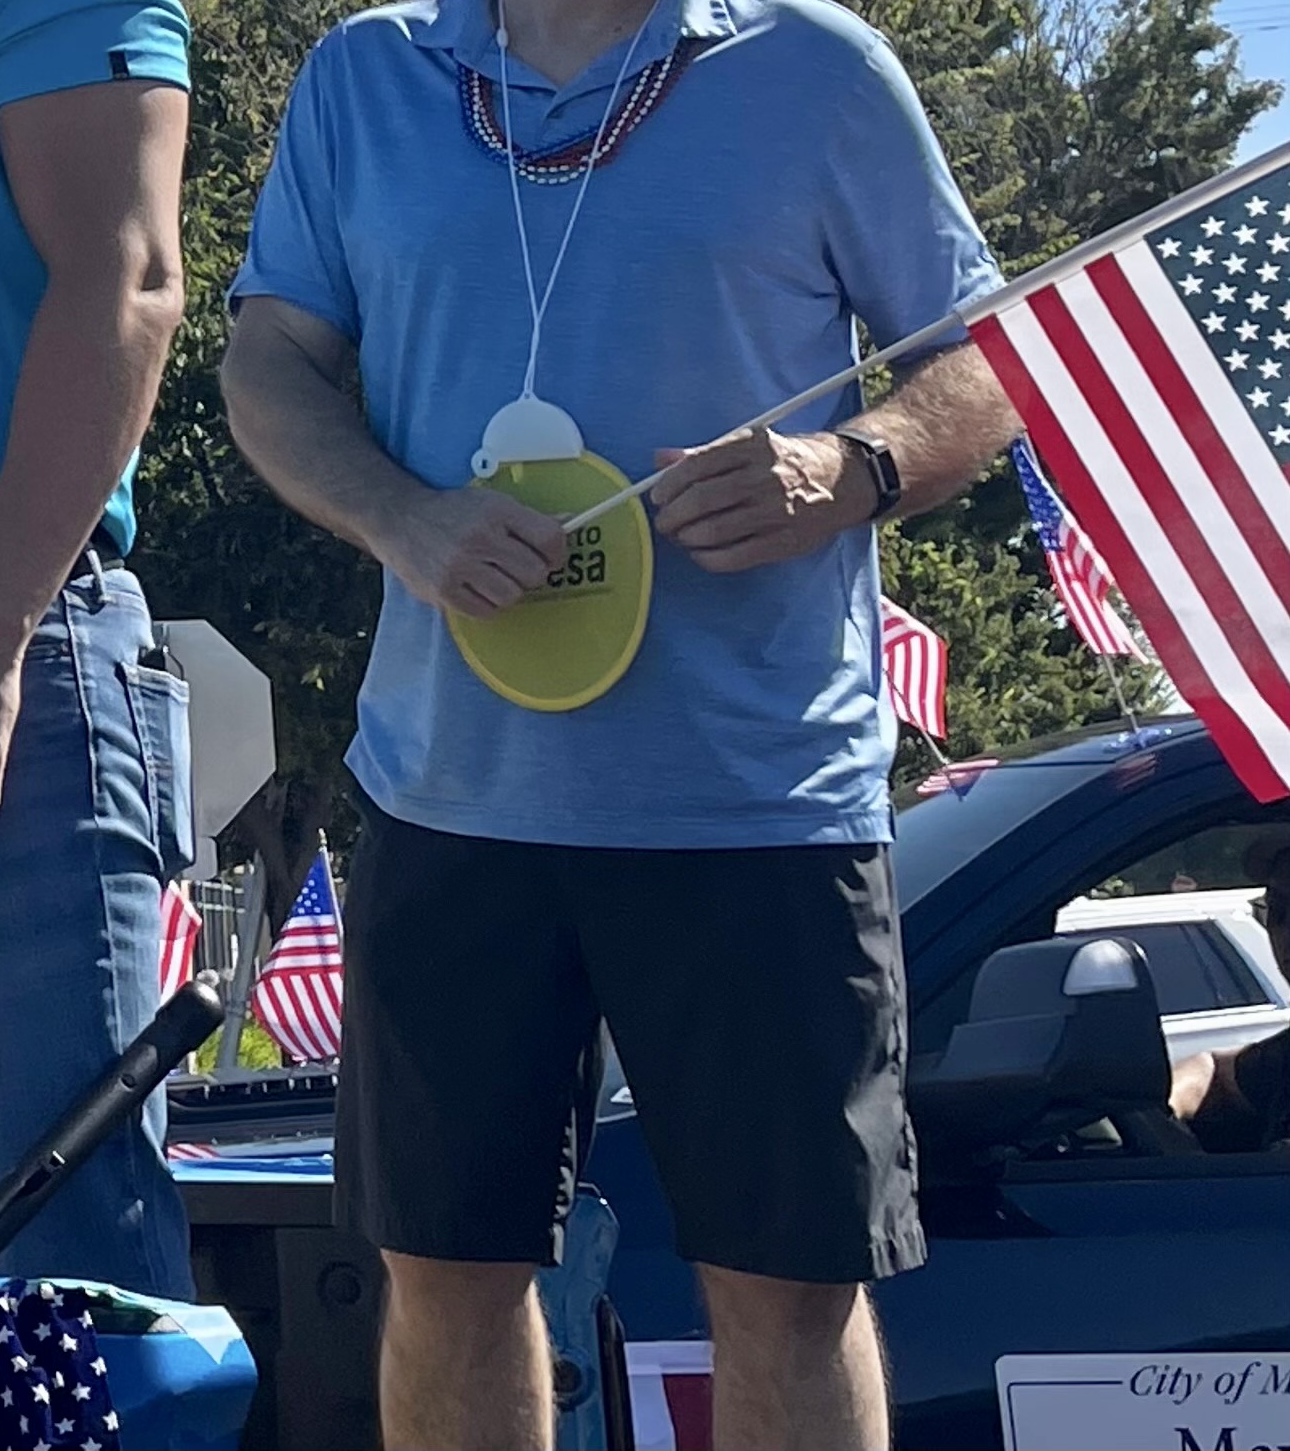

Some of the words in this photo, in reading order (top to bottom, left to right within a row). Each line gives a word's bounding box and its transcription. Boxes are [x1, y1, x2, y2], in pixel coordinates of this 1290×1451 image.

[567, 525, 601, 547] to
[1130, 1364, 1203, 1405] City
[1214, 1361, 1262, 1405] of
